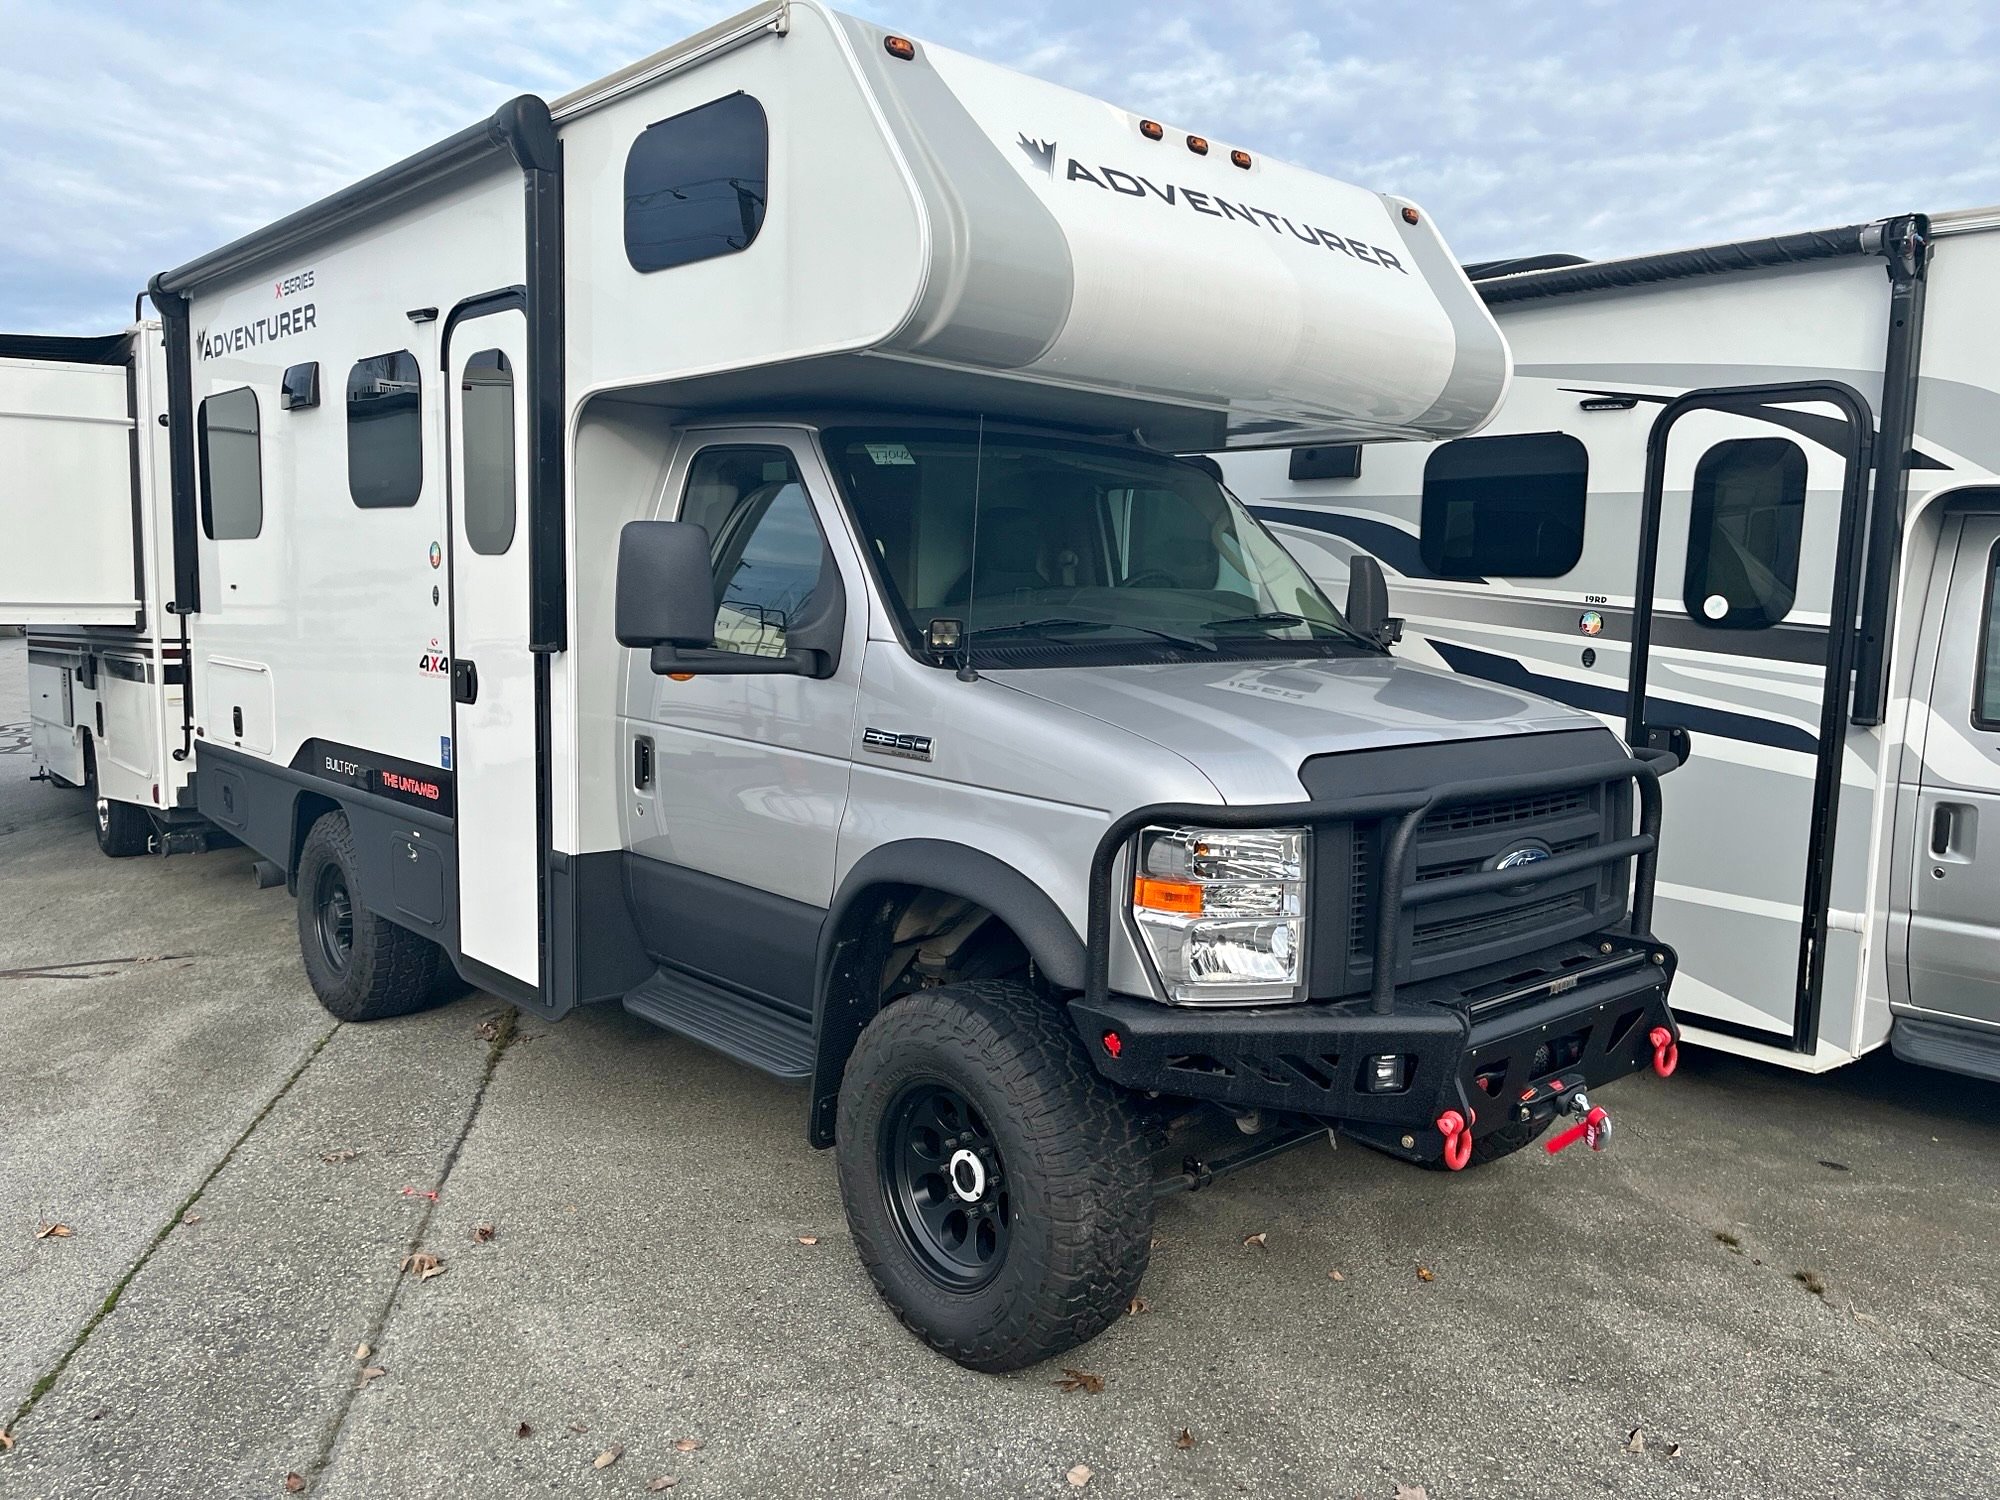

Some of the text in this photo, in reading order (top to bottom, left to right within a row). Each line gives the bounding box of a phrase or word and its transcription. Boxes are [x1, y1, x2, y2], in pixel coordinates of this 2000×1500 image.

[1067, 158, 1409, 275] ADVENTURER
[275, 270, 315, 299] X-SERIES
[203, 303, 317, 361] ADVENTURER
[1585, 595, 1607, 604] 19RD
[419, 654, 449, 674] 4X4
[325, 756, 344, 773] BUILT
[382, 771, 398, 789] THE
[398, 776, 439, 800] UNTAMED
